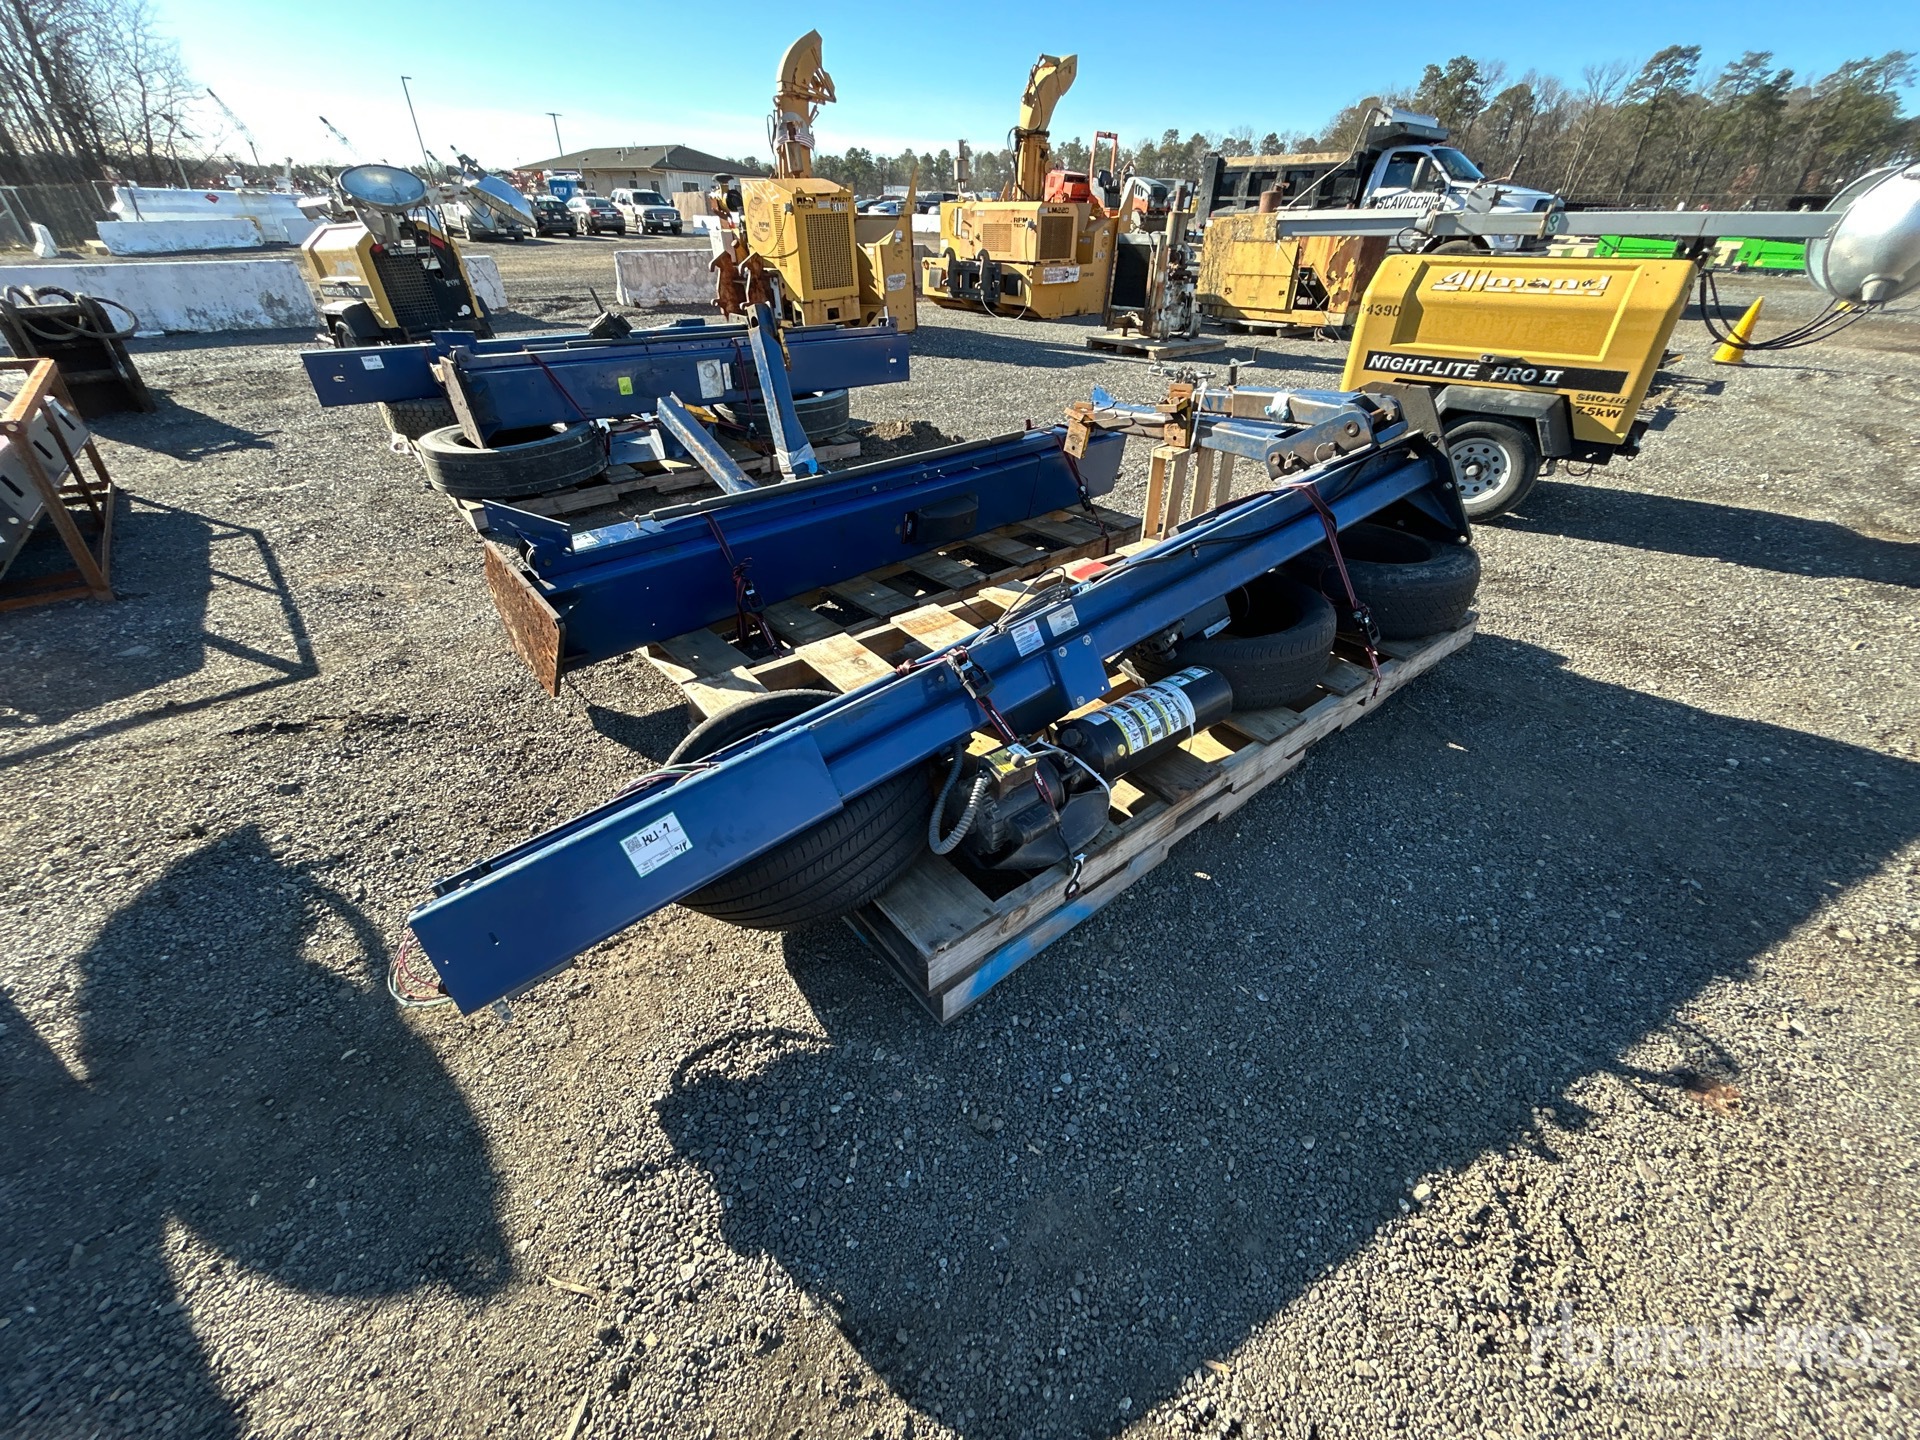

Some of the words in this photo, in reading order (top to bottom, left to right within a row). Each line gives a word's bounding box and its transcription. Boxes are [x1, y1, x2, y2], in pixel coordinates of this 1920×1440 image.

[1431, 270, 1612, 296] Allmand
[1490, 366, 1538, 382] PRO
[1539, 369, 1565, 385] II
[1576, 406, 1622, 419] 7.5kW
